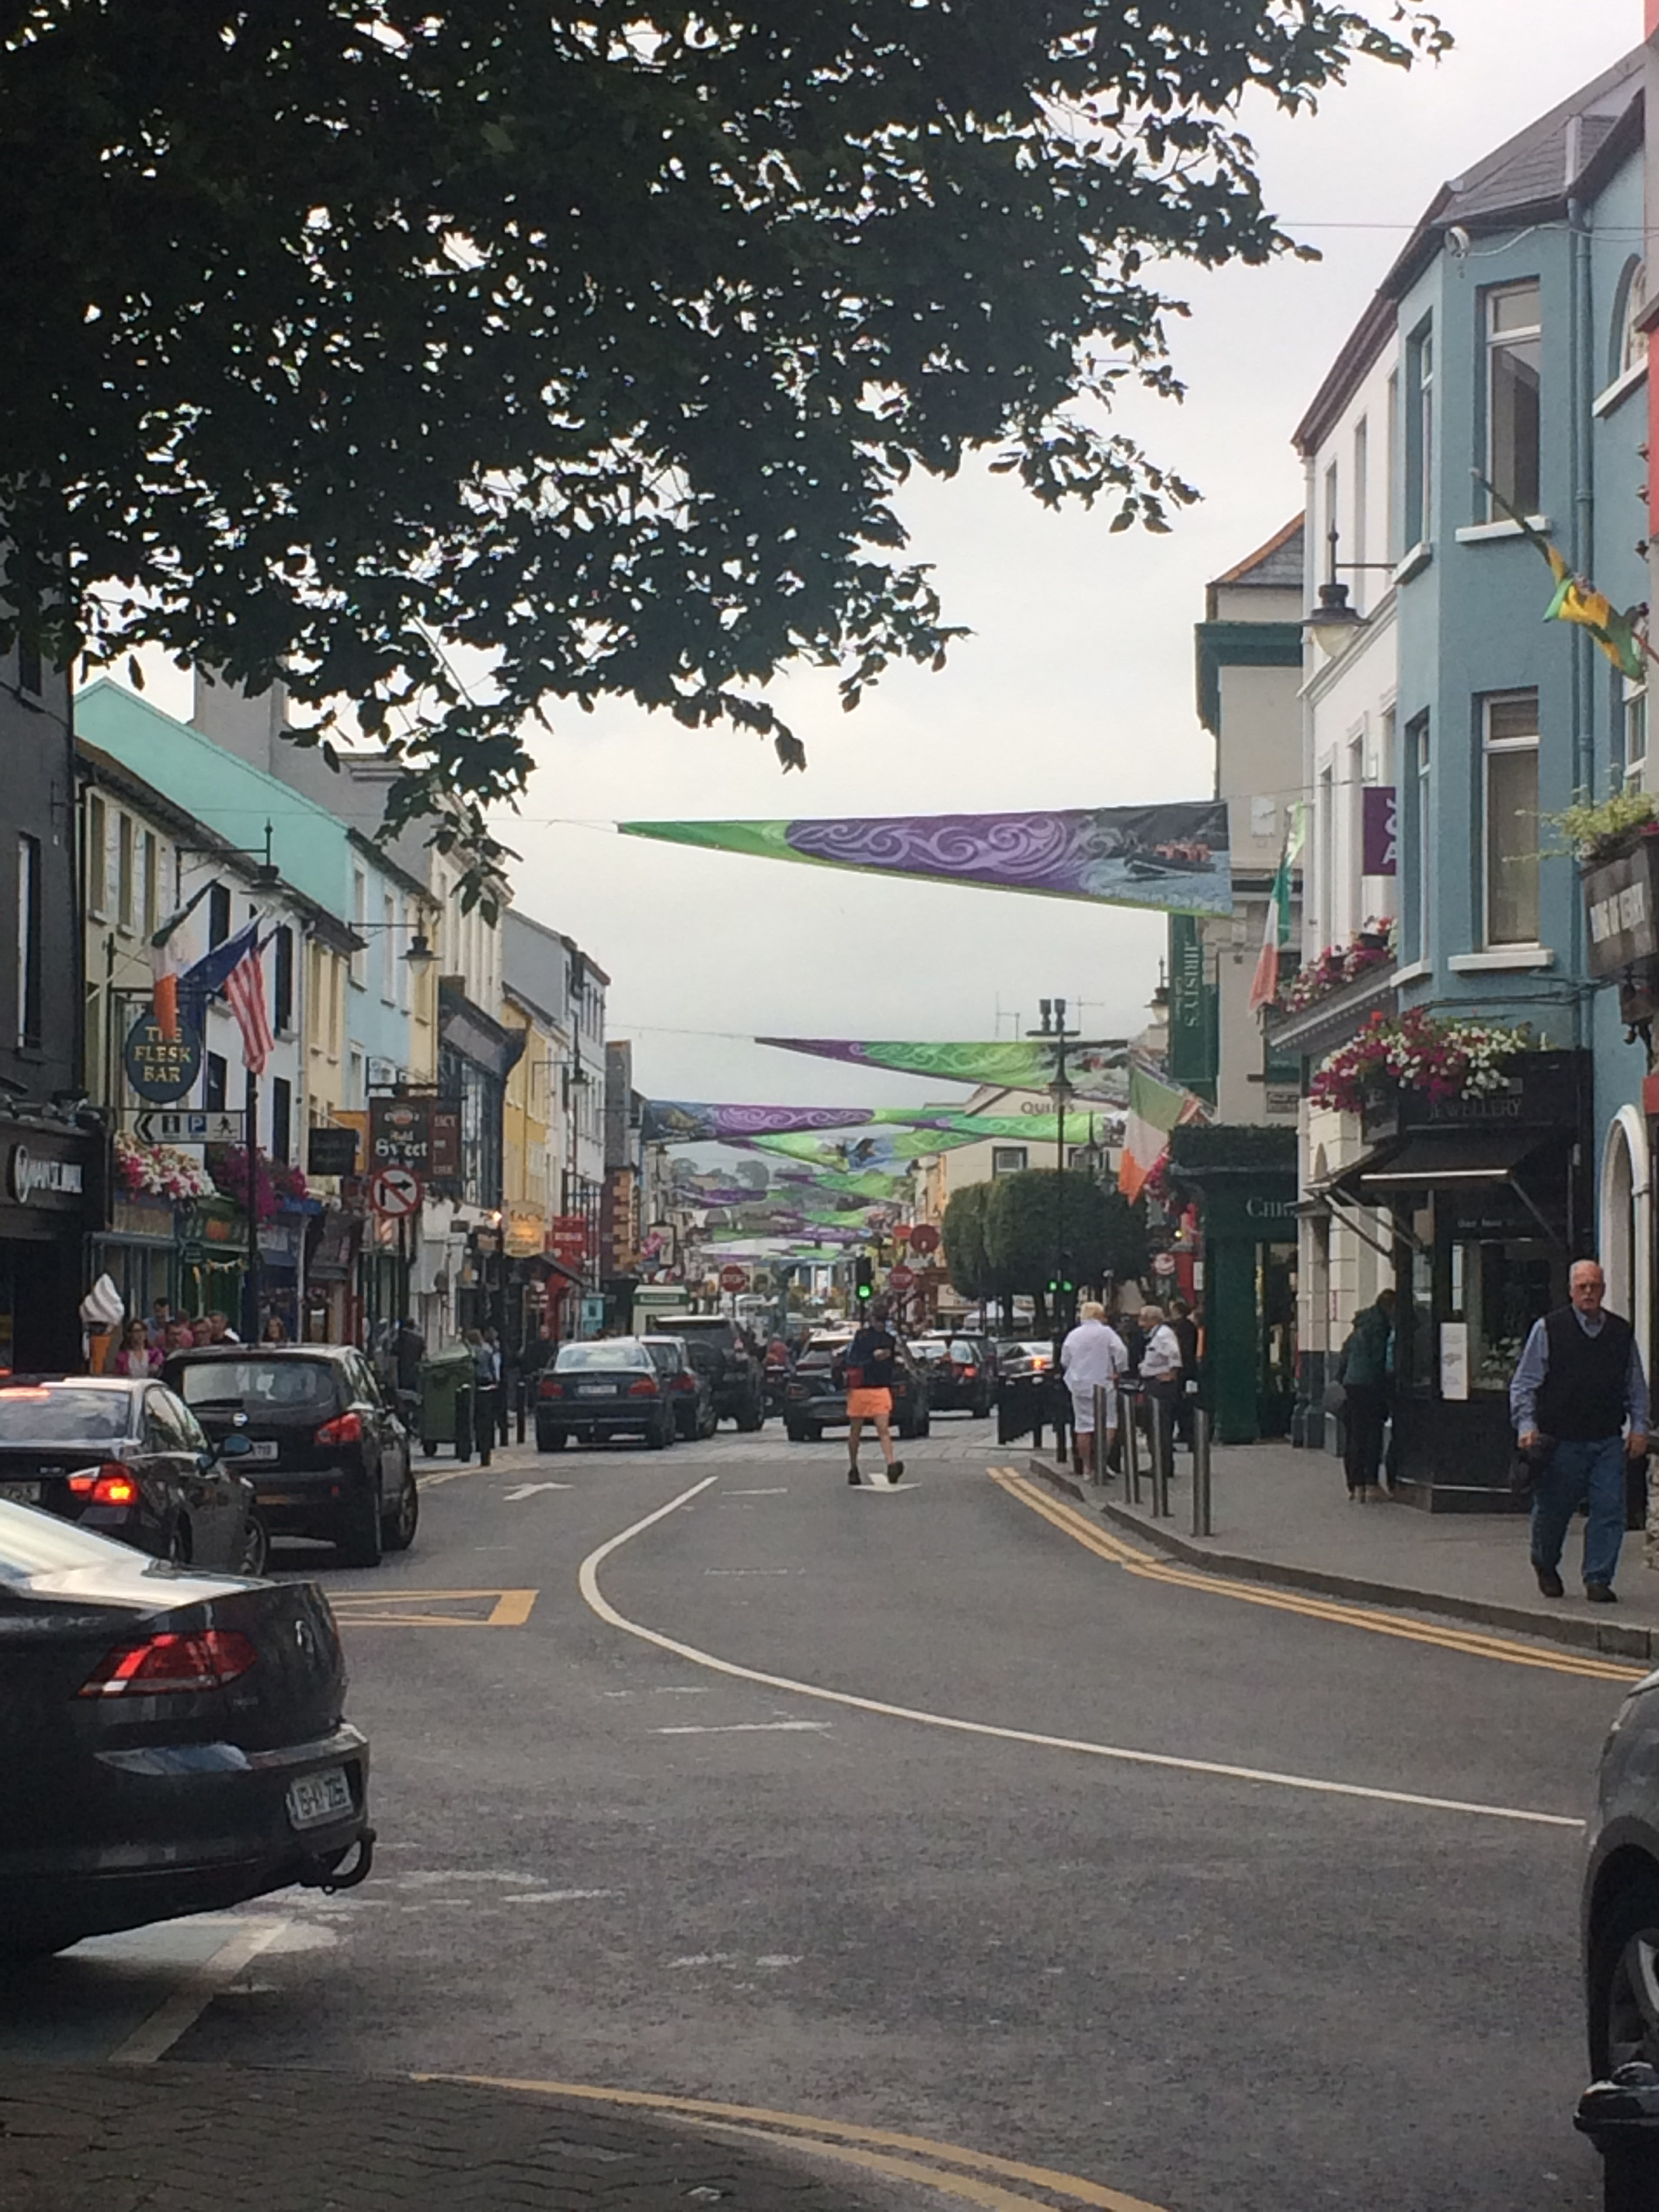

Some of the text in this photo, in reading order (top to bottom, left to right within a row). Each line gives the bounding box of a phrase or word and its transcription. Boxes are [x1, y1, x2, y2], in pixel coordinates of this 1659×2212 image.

[134, 1045, 192, 1063] FLESK
[143, 1065, 181, 1082] BAR
[1431, 1098, 1521, 1119] JEWELLERY
